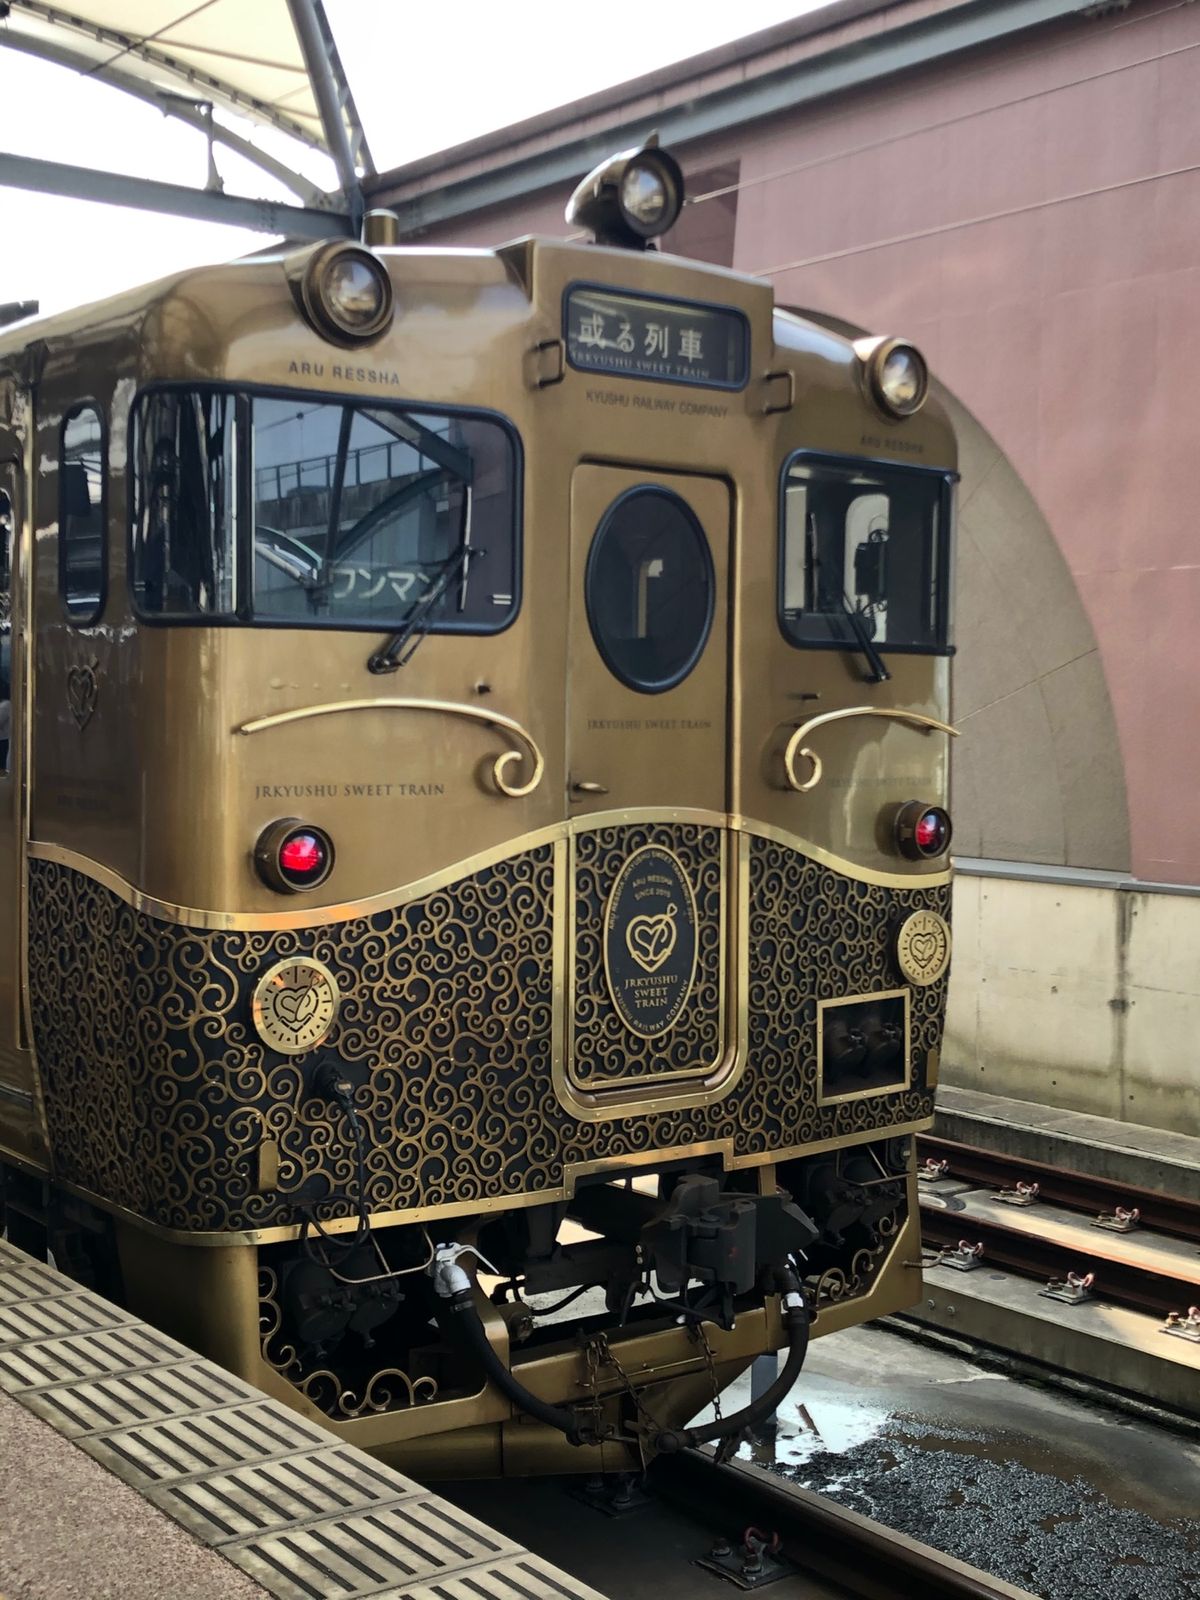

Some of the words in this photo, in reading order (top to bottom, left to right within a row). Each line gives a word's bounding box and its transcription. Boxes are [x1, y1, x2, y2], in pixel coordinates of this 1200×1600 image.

[577, 312, 704, 364] 或る列車
[288, 361, 325, 377] ARU
[332, 365, 400, 385] RESSHA
[586, 389, 630, 408] KYUSHU
[633, 394, 676, 412] RAILWAY
[679, 400, 728, 418] COMPANY
[255, 785, 338, 799] JRKYUSHU
[344, 784, 393, 797] SWEET
[399, 783, 445, 796] TRAIN
[624, 974, 679, 990] JRKYUSHU
[633, 987, 669, 999] SWEET
[634, 997, 668, 1009] TRAIN
[665, 979, 689, 1021] COMPANY
